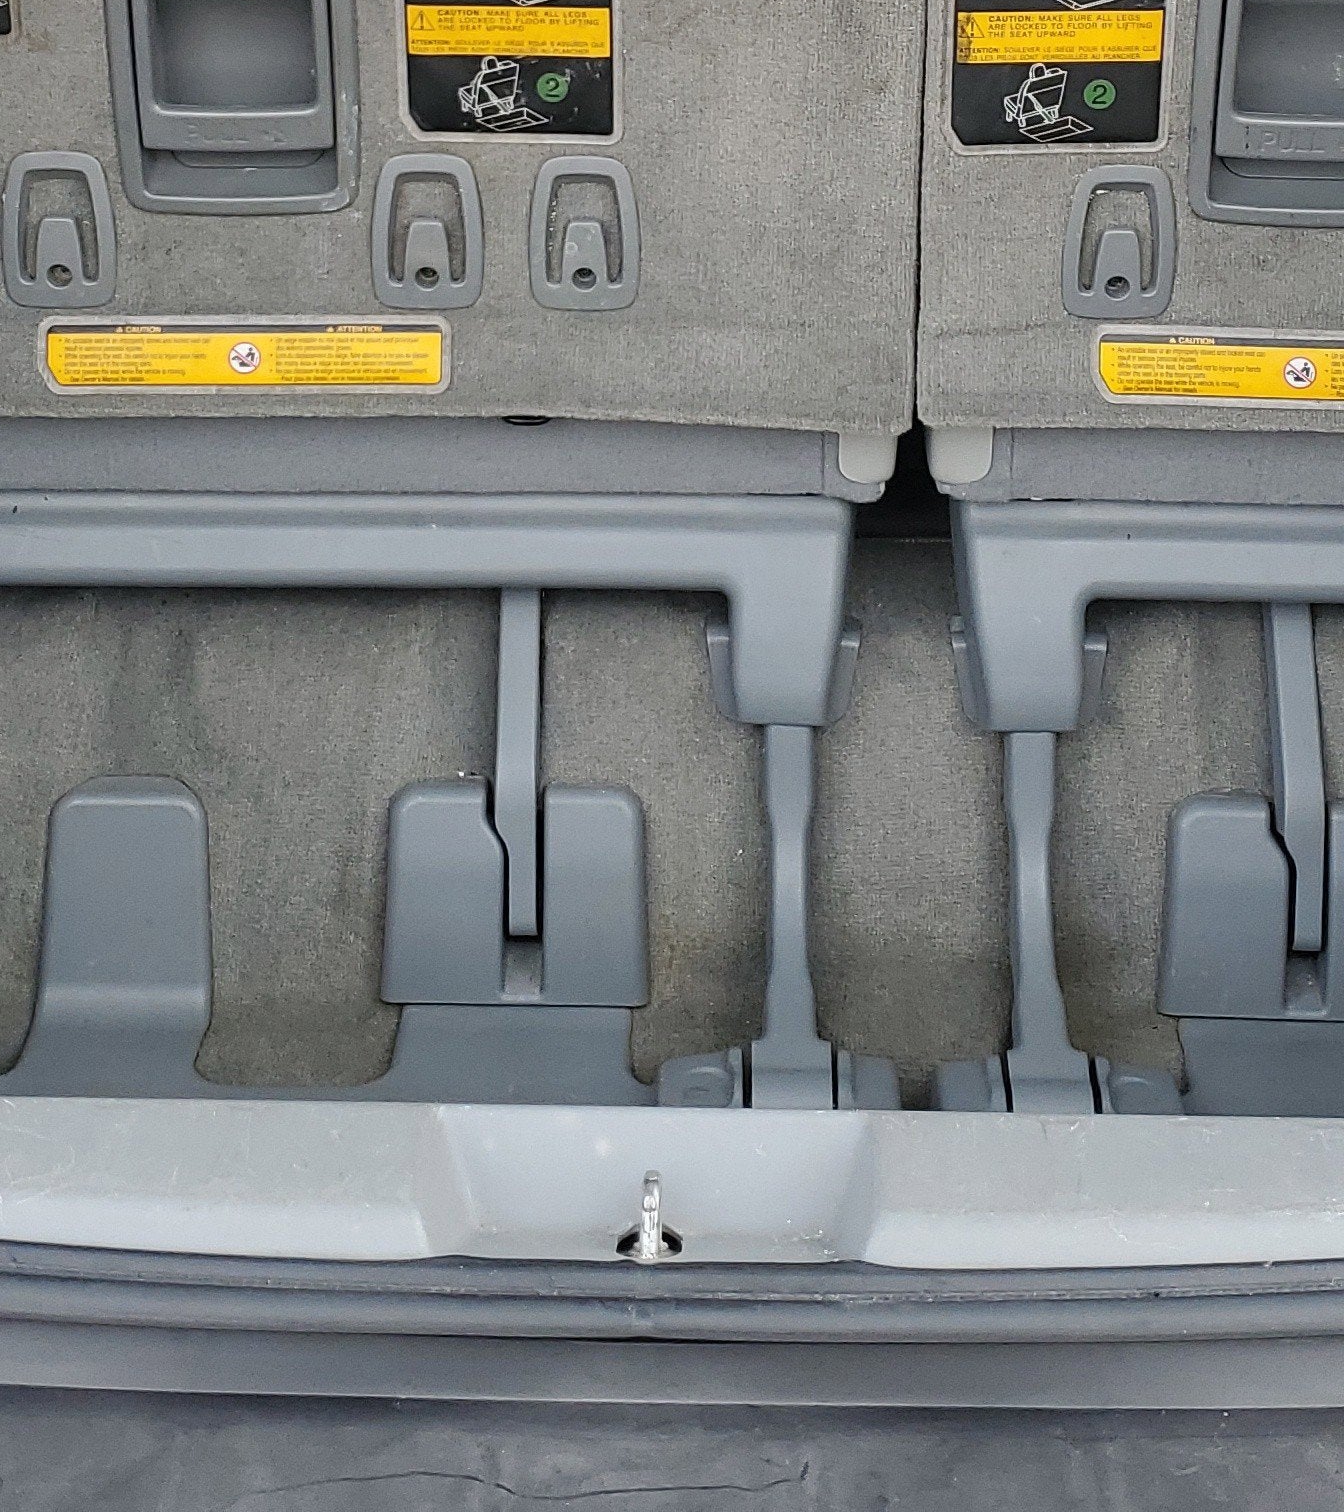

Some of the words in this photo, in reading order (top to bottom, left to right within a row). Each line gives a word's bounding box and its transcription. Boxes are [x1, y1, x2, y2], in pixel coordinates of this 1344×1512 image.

[545, 77, 560, 98] 2
[1091, 84, 1108, 105] 2
[1260, 130, 1325, 153] PULL
[1178, 337, 1215, 345] CAUTION
